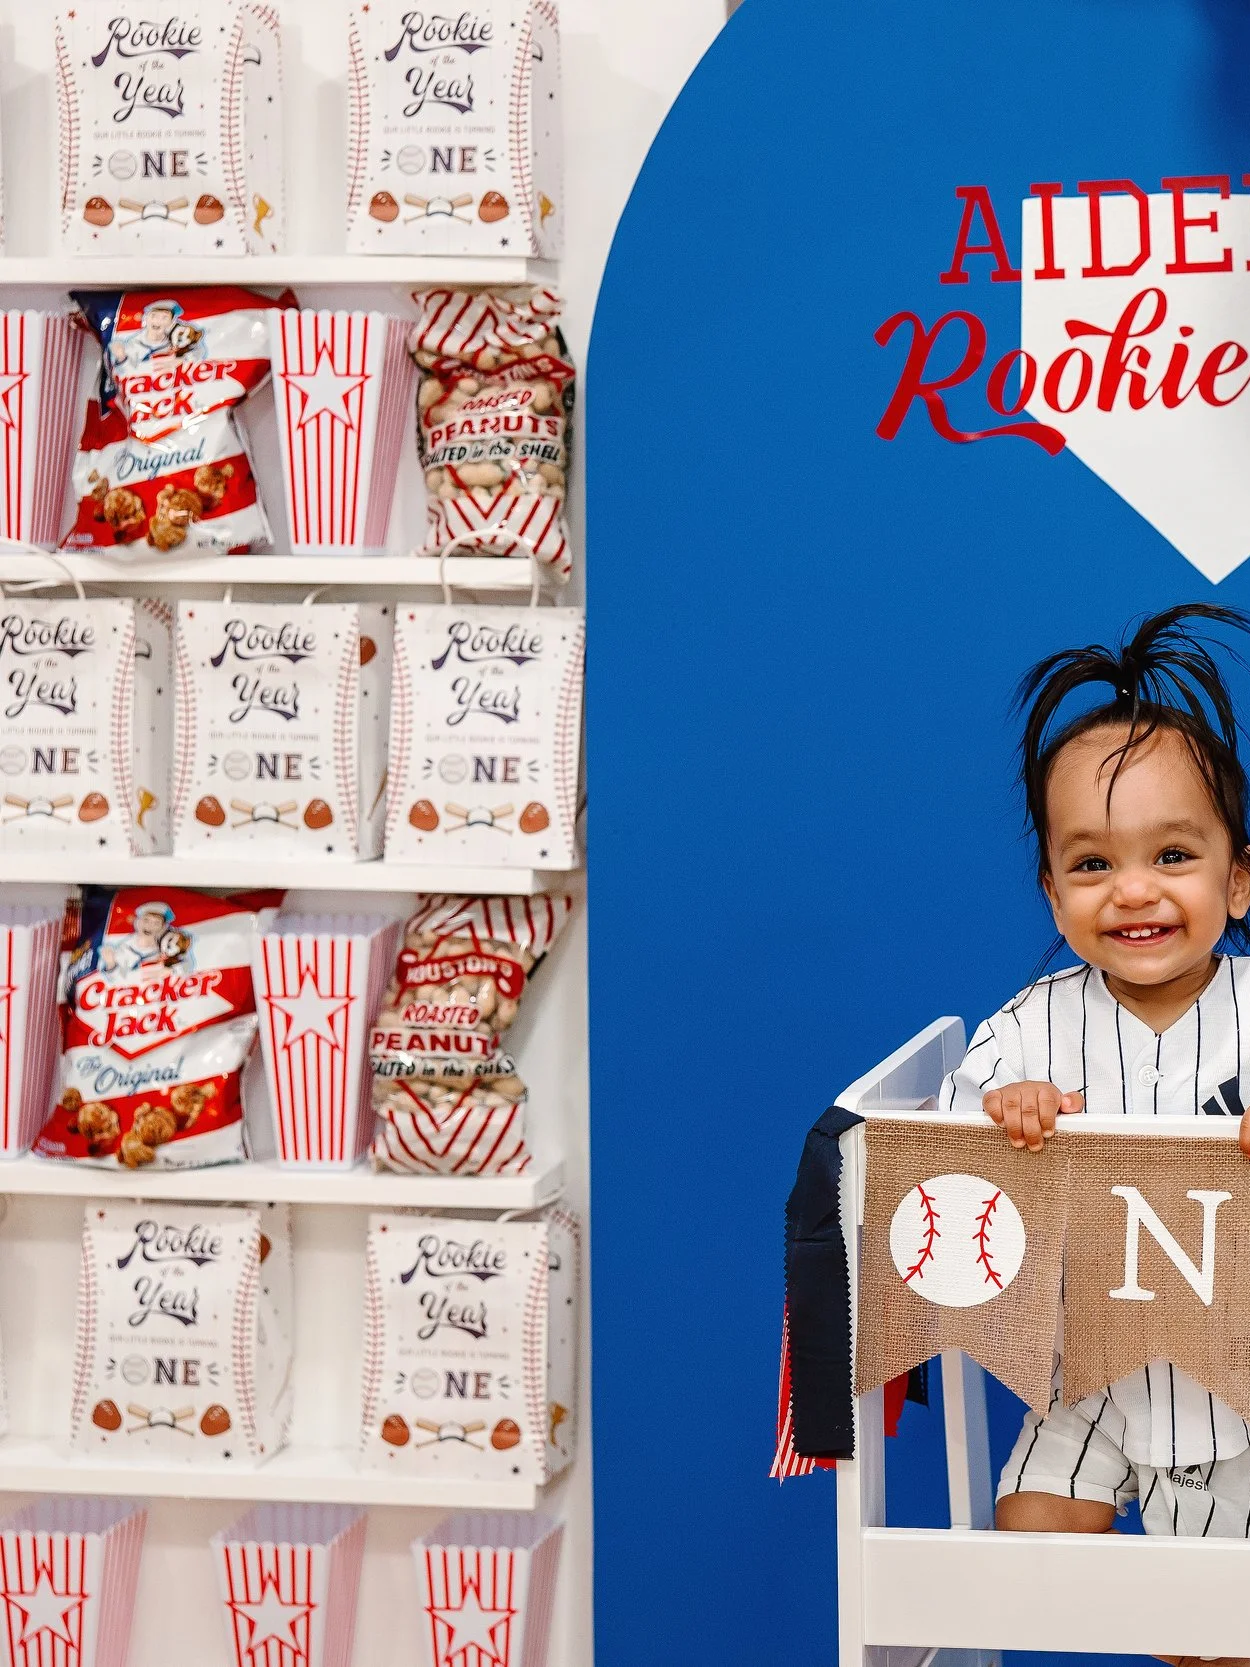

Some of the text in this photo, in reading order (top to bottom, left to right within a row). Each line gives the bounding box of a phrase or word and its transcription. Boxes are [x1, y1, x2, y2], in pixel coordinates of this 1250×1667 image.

[92, 16, 203, 67] Rookie
[384, 11, 493, 61] Rookie
[113, 71, 184, 122] Year
[403, 67, 474, 117] Year
[211, 619, 317, 668] Rookie
[431, 620, 544, 670] Rookie
[5, 668, 77, 718] Year
[229, 673, 300, 723] Year
[446, 676, 521, 726] Year
[79, 974, 222, 1011] Cracker
[91, 1005, 177, 1047] Jack
[95, 1056, 185, 1096] Original
[117, 1219, 224, 1269] Rookie
[400, 1234, 507, 1284] Rookie
[128, 1276, 199, 1327] Year
[418, 1291, 488, 1340] Year
